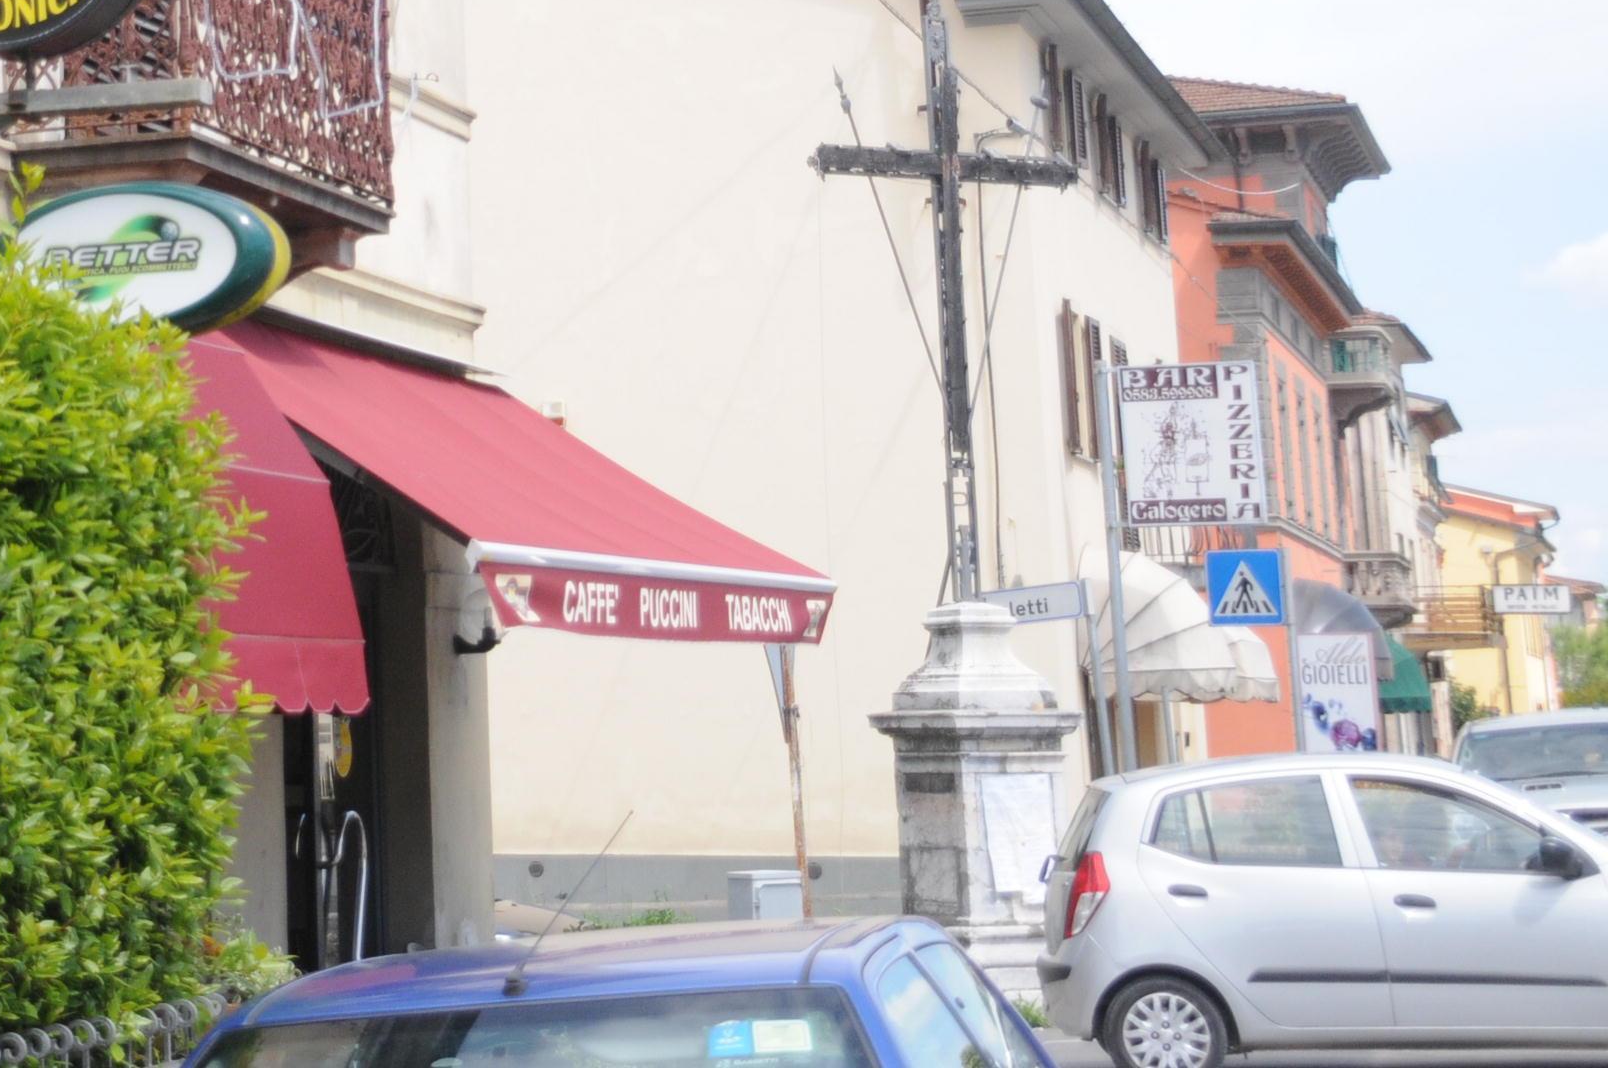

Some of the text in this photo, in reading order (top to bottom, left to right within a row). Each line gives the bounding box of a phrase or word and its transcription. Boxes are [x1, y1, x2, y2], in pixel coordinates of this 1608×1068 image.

[45, 238, 201, 269] BETTER
[1123, 367, 1212, 388] BAR
[1223, 365, 1261, 520] PIZZERIA
[1131, 501, 1226, 523] Calogero
[562, 580, 793, 632] CAFFE' PUCCINI TABACCHI
[1008, 598, 1049, 617] letti
[1302, 664, 1368, 685] GIOIELLI
